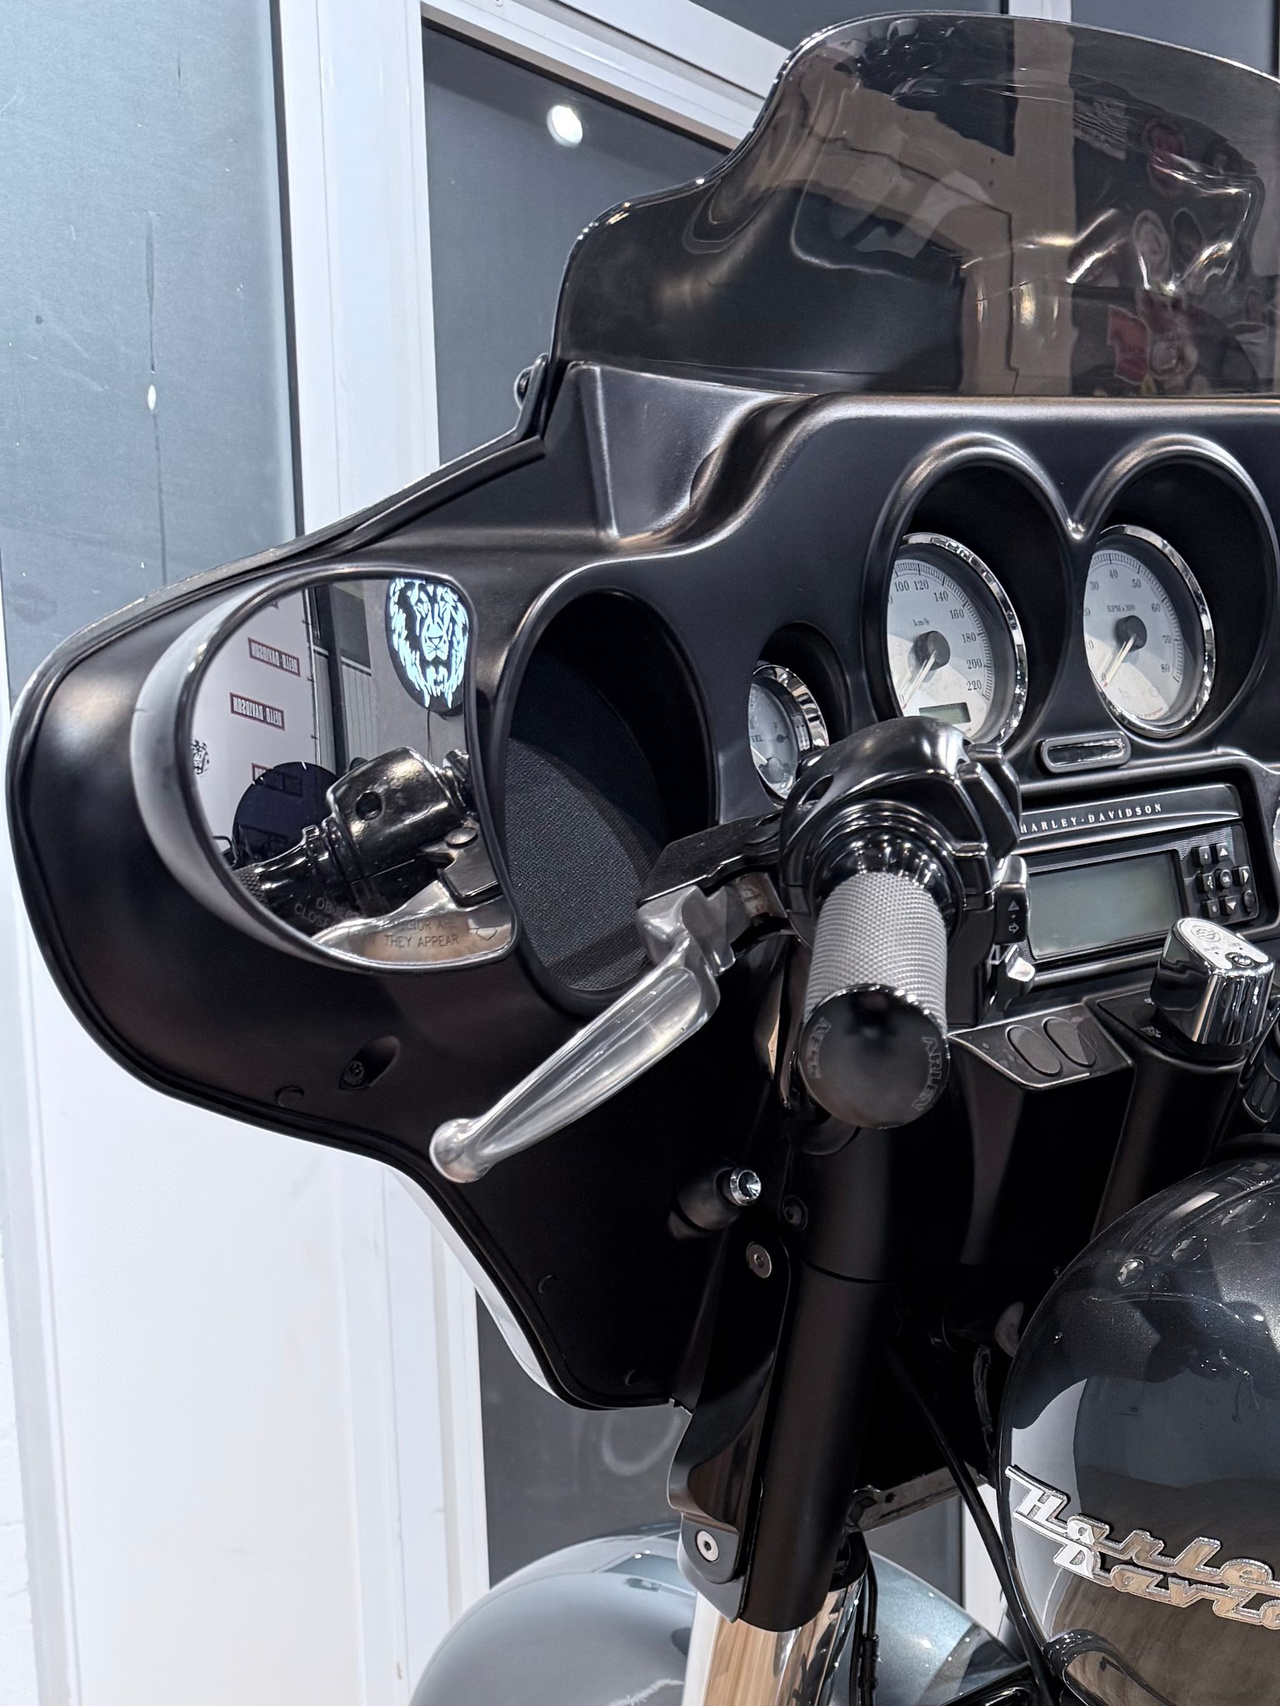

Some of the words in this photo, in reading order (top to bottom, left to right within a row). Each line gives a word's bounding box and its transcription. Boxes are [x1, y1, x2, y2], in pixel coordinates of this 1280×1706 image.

[894, 581, 910, 593] 100
[913, 580, 930, 591] 120
[933, 591, 949, 603] 140
[950, 608, 965, 620] 160
[962, 632, 977, 644] 180
[966, 658, 983, 670] 200
[966, 680, 982, 691] 220
[417, 933, 460, 948] APPEAR
